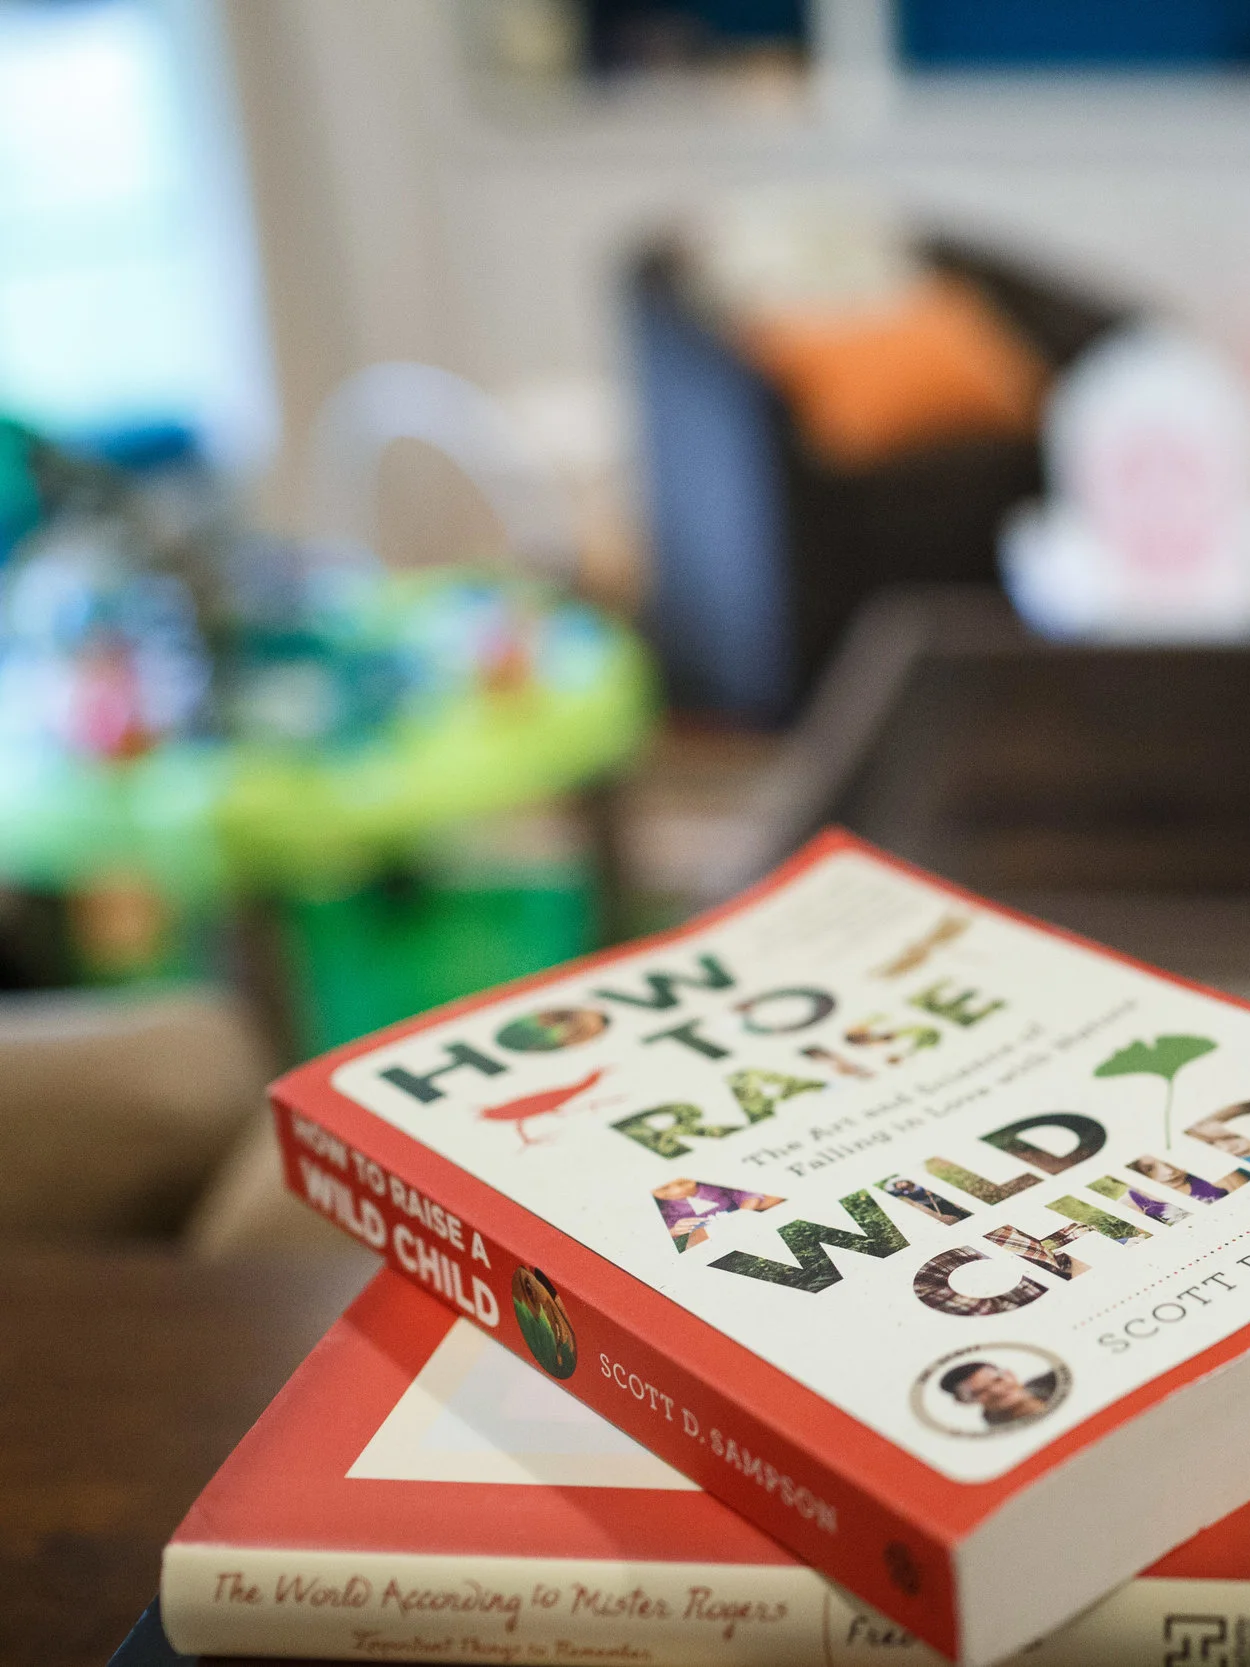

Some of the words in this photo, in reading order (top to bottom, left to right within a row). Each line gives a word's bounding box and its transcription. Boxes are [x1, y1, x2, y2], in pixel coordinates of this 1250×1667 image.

[380, 952, 736, 1104] HOW
[609, 973, 1007, 1160] RAISE
[640, 985, 838, 1061] TO
[291, 1112, 349, 1171] HOW
[353, 1150, 387, 1197] TO
[388, 1174, 466, 1253] RAISE
[471, 1231, 492, 1270] A
[743, 1140, 802, 1169] The
[810, 1114, 857, 1142] Art
[787, 1126, 894, 1178] Falling
[891, 1112, 926, 1134] in
[930, 1084, 991, 1119] Love
[300, 1157, 387, 1249] WILD
[393, 1223, 500, 1328] CHILD
[651, 1177, 788, 1254] A
[706, 1111, 1108, 1294] WILD
[1098, 1271, 1237, 1354] SCOTT
[599, 1352, 674, 1422] SCOTT
[681, 1407, 706, 1444] D.
[709, 1427, 838, 1535] SAMPSON
[214, 1570, 262, 1605] The
[274, 1573, 374, 1609] World
[380, 1576, 522, 1634] According
[531, 1580, 561, 1609] to
[571, 1580, 669, 1621] Mister
[682, 1583, 789, 1643] Rogers
